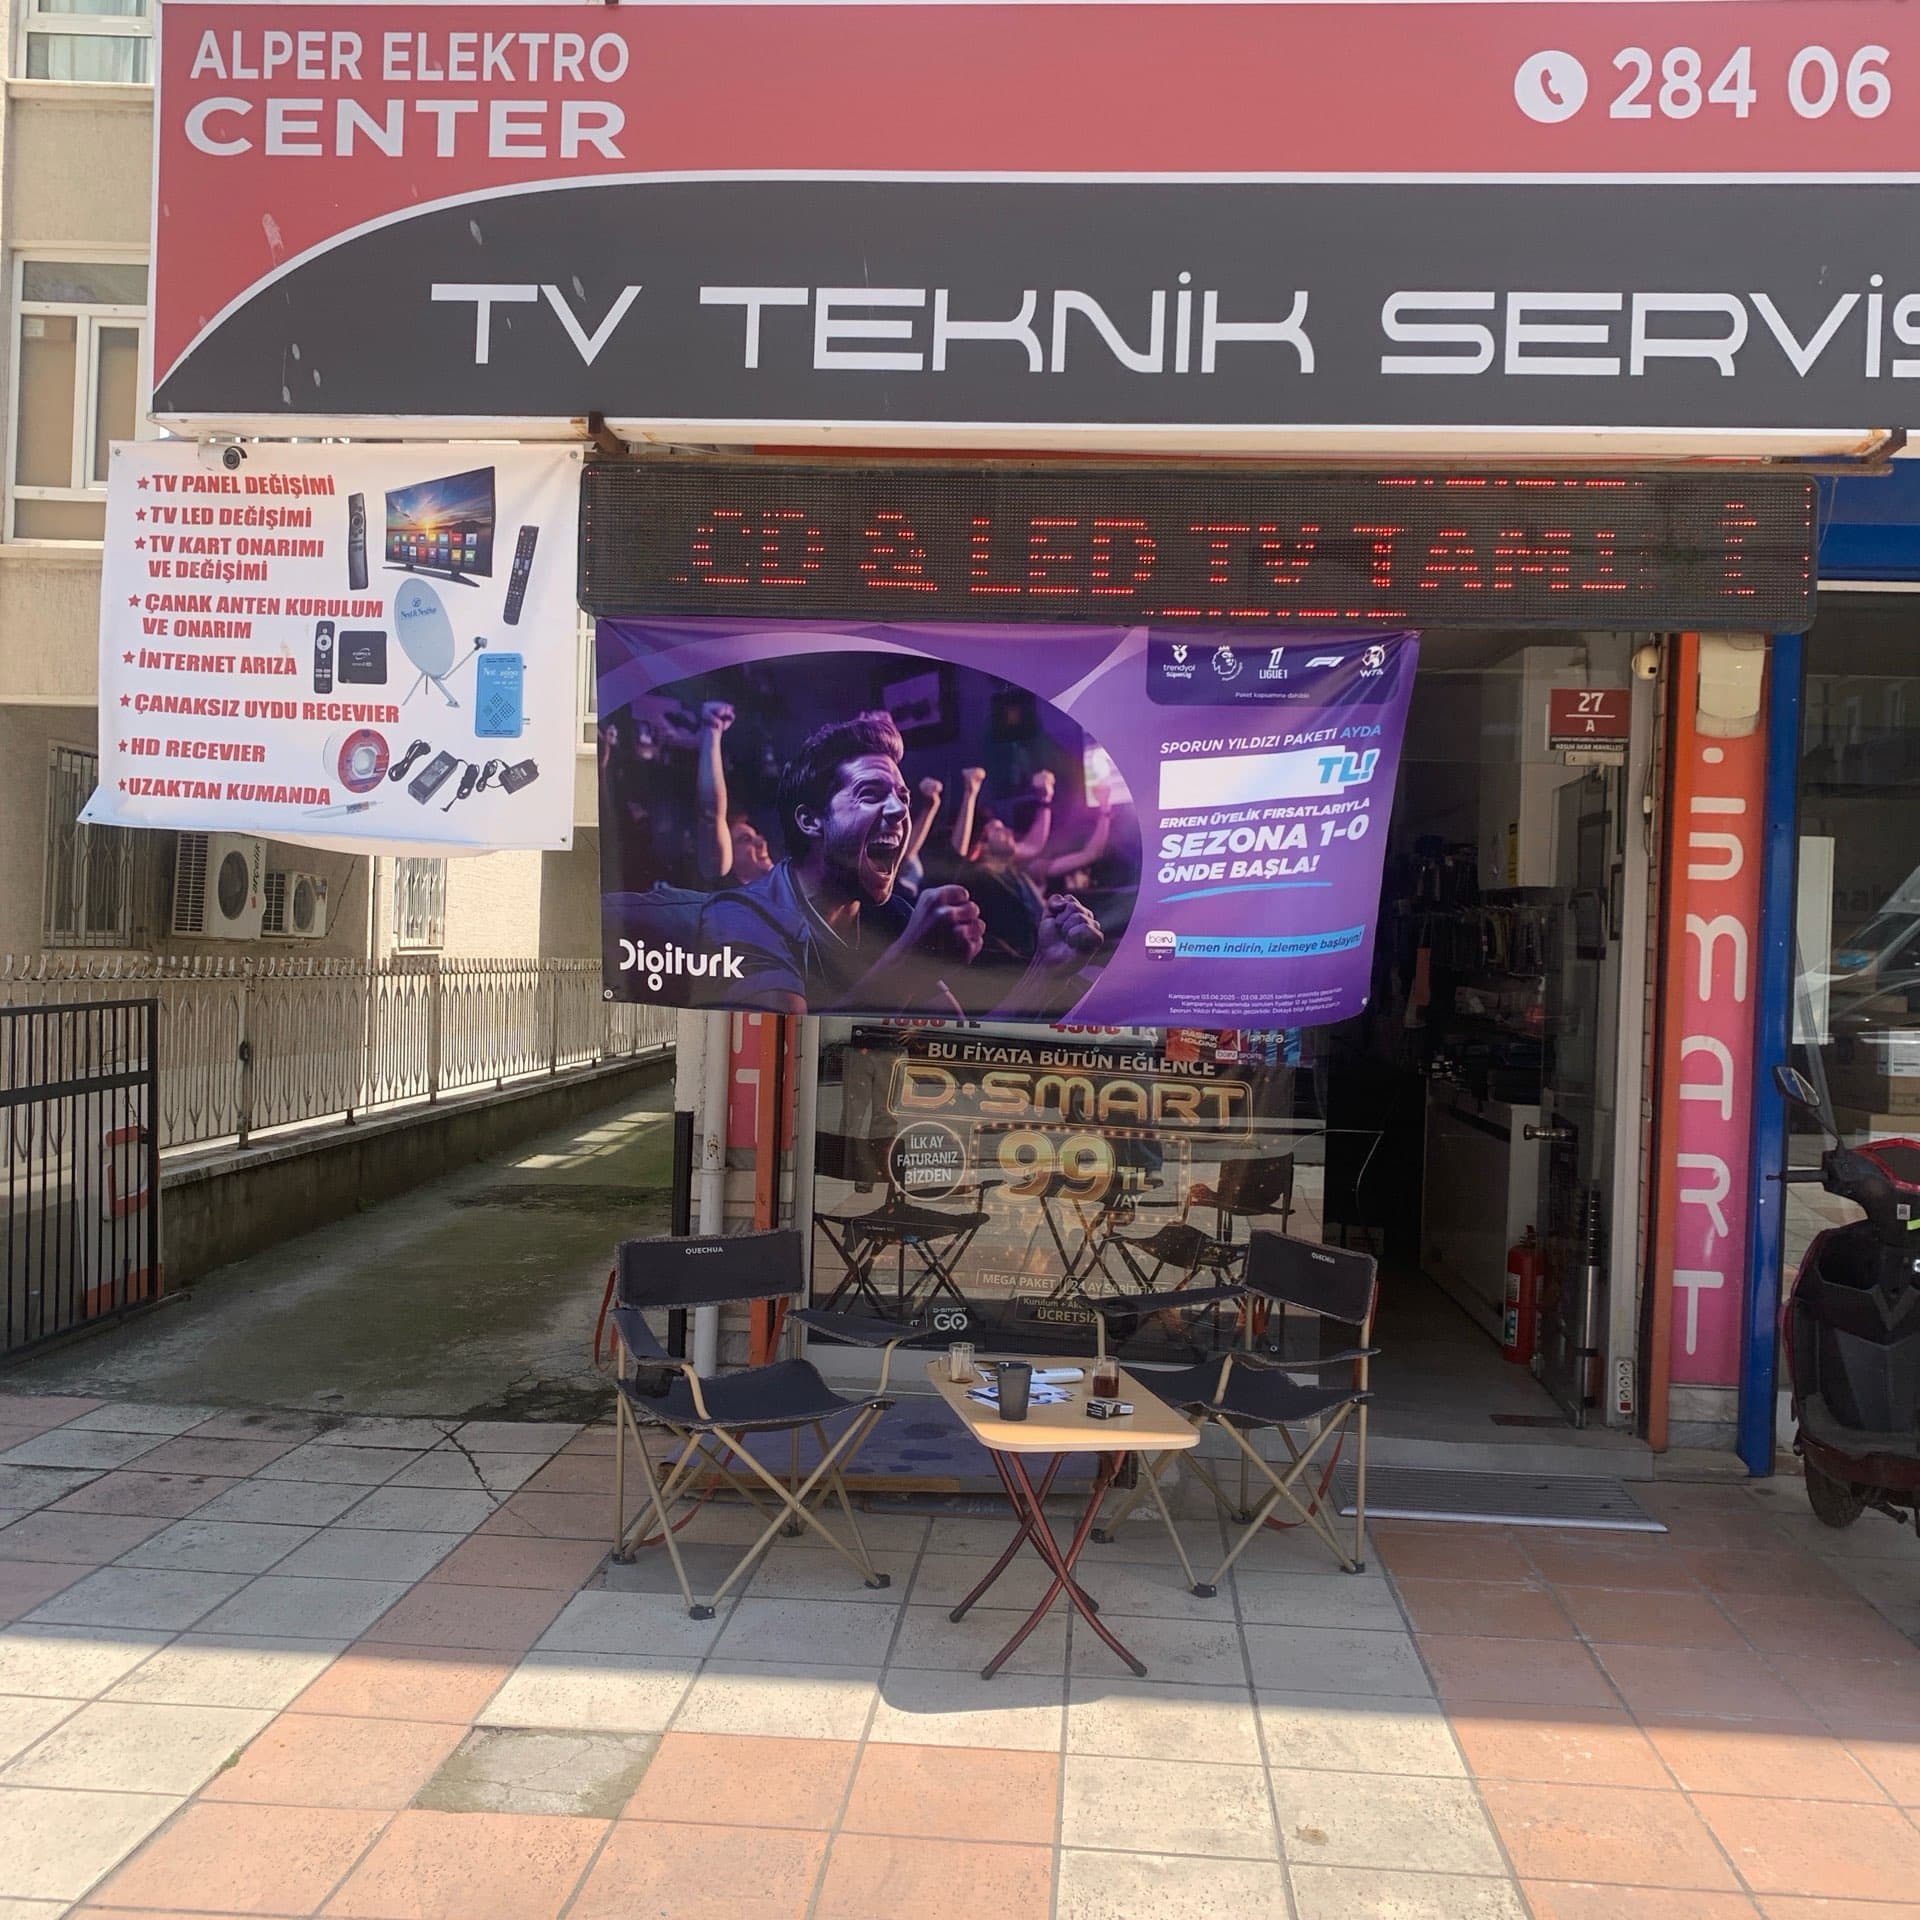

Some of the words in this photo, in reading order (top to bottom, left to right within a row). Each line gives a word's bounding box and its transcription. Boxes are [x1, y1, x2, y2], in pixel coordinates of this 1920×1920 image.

[190, 30, 362, 80] ALPER
[382, 32, 629, 83] ELEKTRO
[1609, 46, 1756, 119] 284
[1788, 45, 1892, 118] 06
[185, 97, 626, 158] CENTER
[431, 284, 642, 366] TV
[700, 271, 1314, 374] TEKNİK
[1381, 274, 1920, 378] SERVİ
[151, 474, 178, 494] TV
[181, 475, 241, 495] PANEL
[244, 473, 335, 498] DEĞİŞİMİ
[150, 506, 177, 526] TV
[180, 507, 213, 527] LED
[218, 506, 312, 530] DEĞİŞİMİ
[149, 535, 176, 554] TV
[179, 536, 232, 555] KART
[236, 537, 325, 557] ONARIMI
[971, 518, 1156, 595] LED
[1188, 522, 1323, 586] TV
[148, 560, 171, 578] VE
[176, 559, 269, 583] DEĞİŞİMİ
[145, 593, 212, 617] ÇANAK
[216, 595, 281, 615] ANTEN
[285, 597, 383, 618] KURULUM
[142, 617, 169, 636] VE
[173, 619, 252, 639] ONARIM
[138, 649, 236, 674] İNTERNET
[240, 656, 297, 676] ARIZA
[134, 693, 241, 718] ÇANAKSIZ
[245, 700, 299, 720] UYDU
[303, 702, 400, 723] RECEVIER
[1578, 692, 1604, 712] 27
[1585, 720, 1595, 732] A
[130, 738, 162, 757] HD
[165, 740, 266, 763] RECEVIER
[1160, 739, 1222, 754] SPORUN
[1227, 735, 1280, 752] YILDIZI
[1283, 728, 1337, 746] PAKETİ
[1340, 724, 1382, 740] AYDA
[1318, 753, 1376, 784] TL!
[129, 777, 223, 801] UZAKTAN
[226, 783, 331, 805] KUMANDA
[1159, 815, 1209, 829] ERKEN
[1210, 807, 1261, 826] ÜYELİK
[1263, 798, 1371, 821] FIRSATLARIYLA
[1158, 822, 1308, 860] SEZONA
[1320, 814, 1369, 847] 1-0
[1158, 860, 1226, 884] ÖNDE
[1229, 855, 1319, 882] BAŞLA!
[1178, 942, 1221, 953] Hemen
[1267, 942, 1318, 954] izlemeye
[619, 938, 745, 992] Digiturk
[927, 1042, 957, 1060] BU
[963, 1042, 1033, 1064] FİYATA
[1040, 1047, 1113, 1070] BÜTÜN
[1119, 1052, 1215, 1076] EĞLENCE
[910, 1134, 929, 1150] İLK
[930, 1135, 944, 1148] AY
[896, 1151, 958, 1167] FATURANIZ
[997, 1130, 1116, 1205] 99
[904, 1167, 952, 1185] BİZDEN
[1119, 1167, 1153, 1191] TL
[685, 1247, 724, 1255] QUECHUA
[983, 1274, 1017, 1285] MEGA
[1019, 1277, 1056, 1289] PAKET
[1088, 1282, 1102, 1293] AY
[934, 1313, 968, 1331] GO
